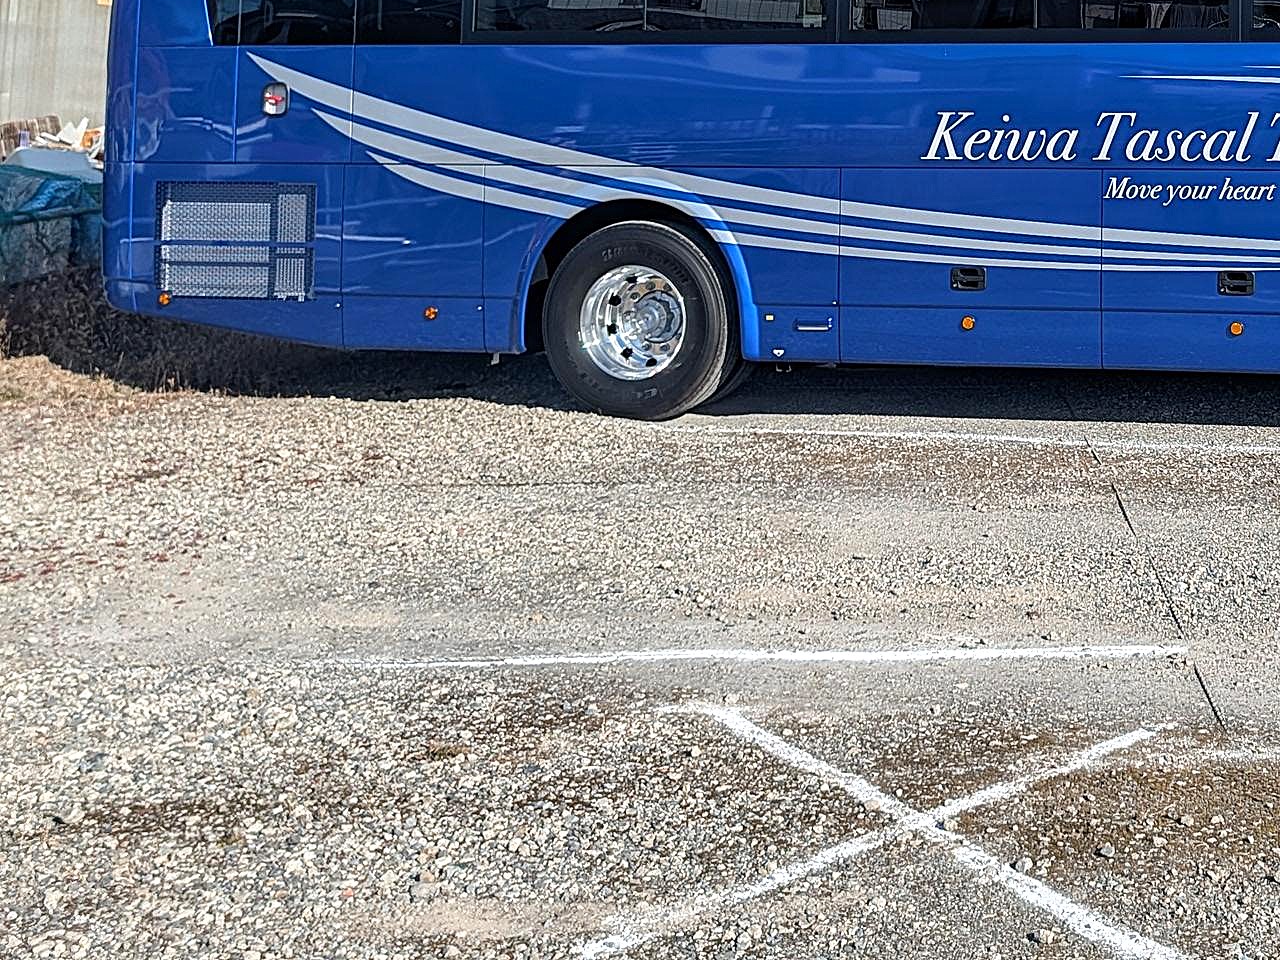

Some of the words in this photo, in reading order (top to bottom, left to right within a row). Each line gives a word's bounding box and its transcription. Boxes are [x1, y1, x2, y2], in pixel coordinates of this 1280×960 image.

[920, 111, 1078, 161] Keiwa
[1092, 111, 1260, 162] Tascal
[1102, 176, 1163, 200] Move
[1162, 184, 1217, 207] your
[1218, 176, 1277, 201] heart
